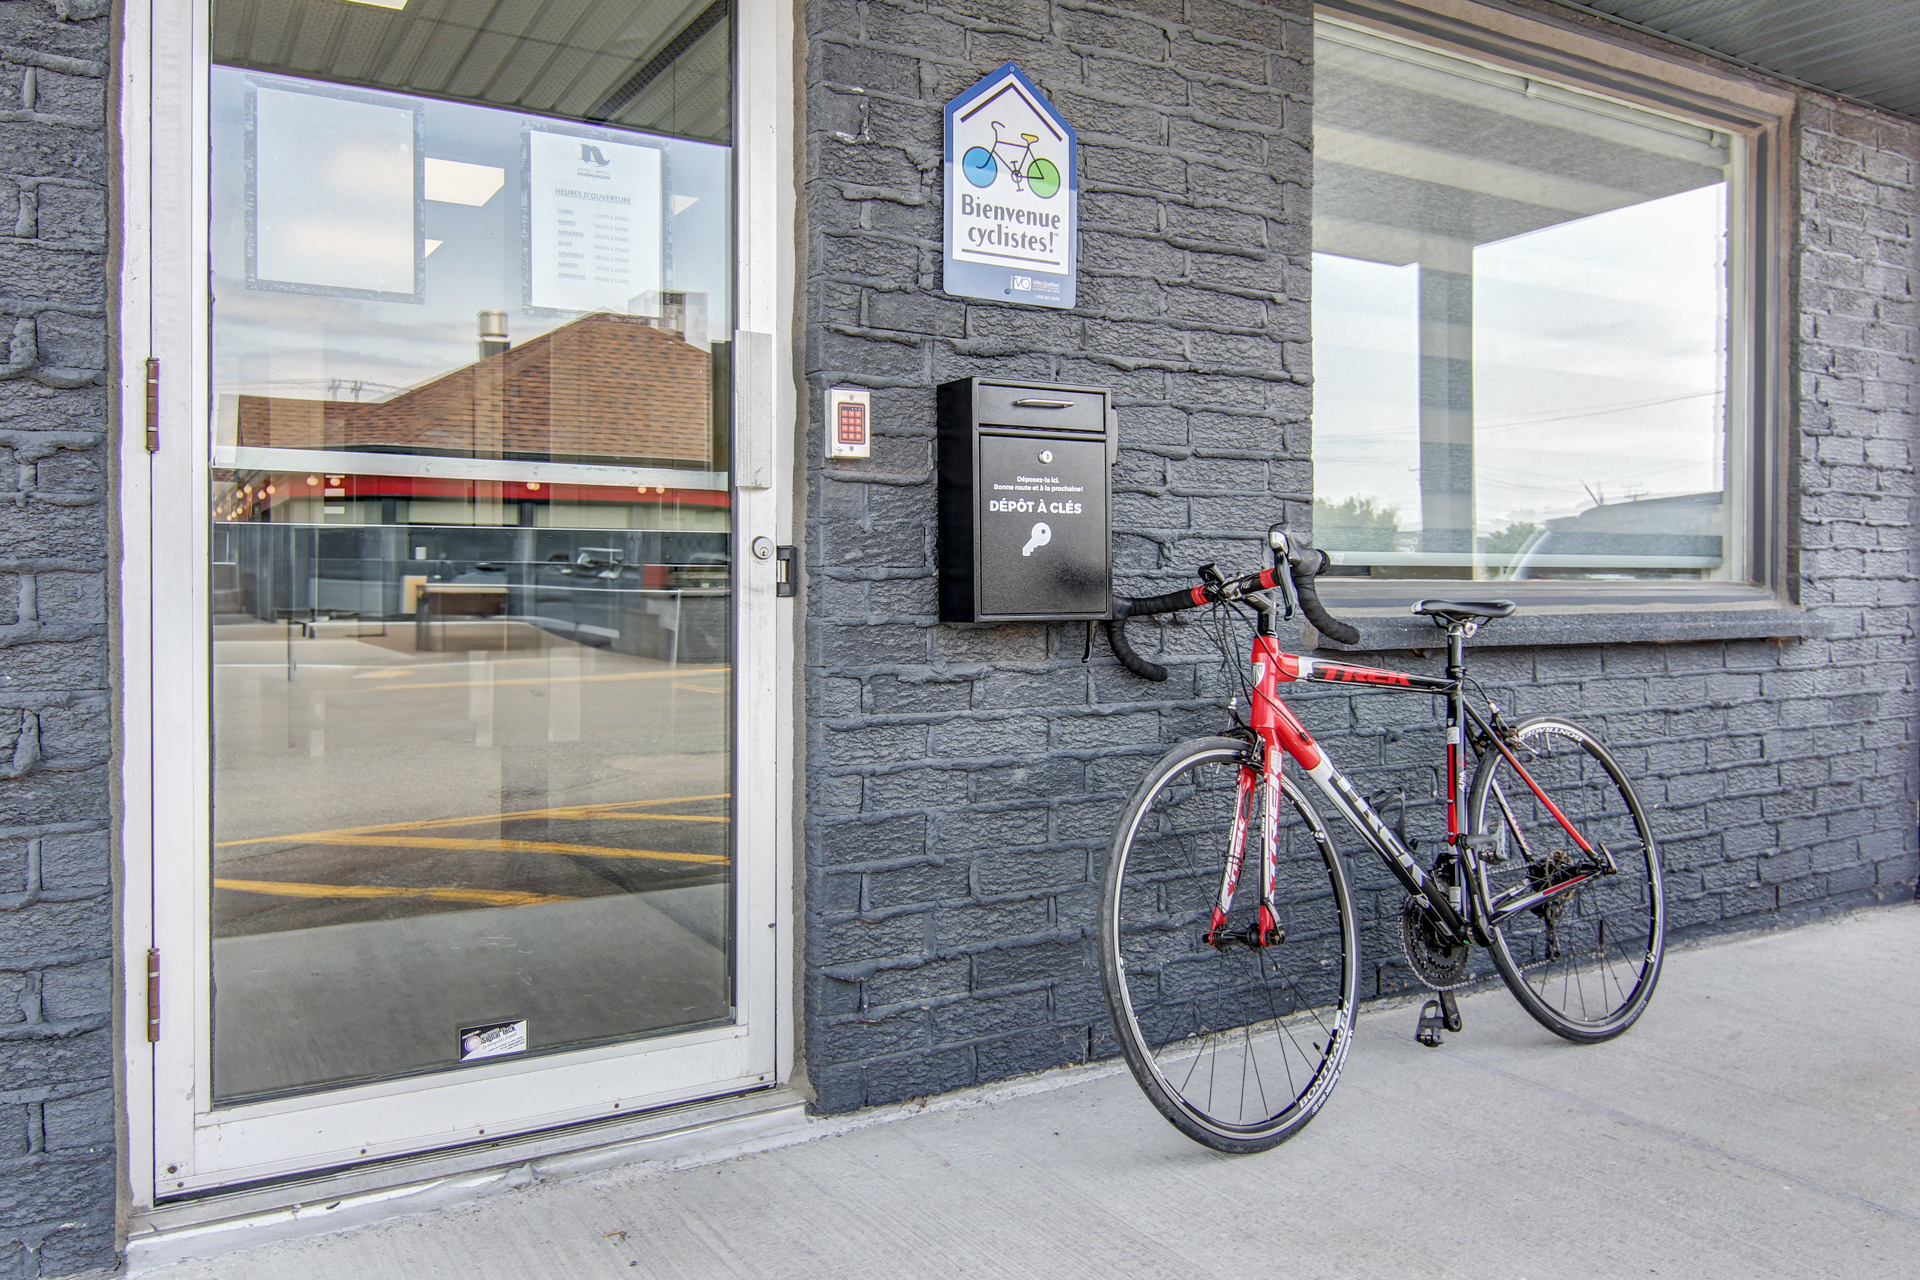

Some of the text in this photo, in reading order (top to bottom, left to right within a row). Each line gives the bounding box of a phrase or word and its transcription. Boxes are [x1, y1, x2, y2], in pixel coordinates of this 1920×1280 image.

[577, 171, 611, 180] NORMANDIN
[555, 188, 631, 205] HEURES D'OUVERTURE
[961, 193, 1061, 230] Bienvenue
[968, 223, 1054, 254] cyclistes!
[1017, 476, 1050, 484] Déposez-la
[1051, 485, 1084, 493] prochaine!
[989, 497, 1082, 514] DÉPÔT À CLÉS
[1320, 665, 1411, 686] TREK
[1299, 1000, 1350, 1109] BONTRAGER
